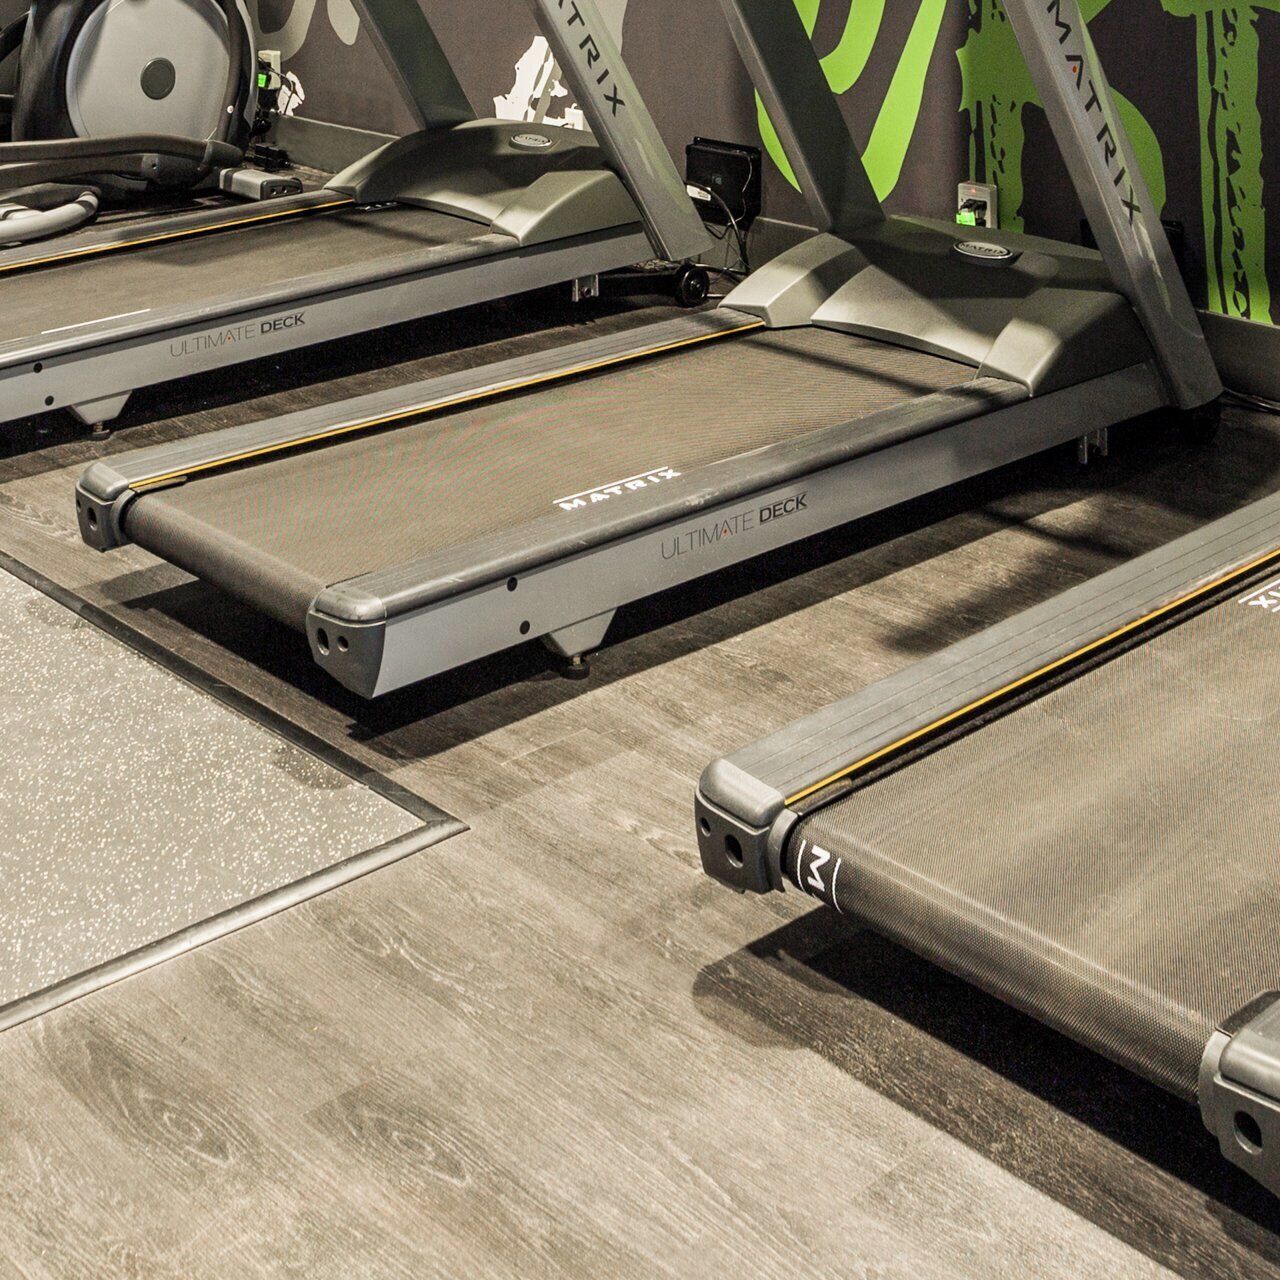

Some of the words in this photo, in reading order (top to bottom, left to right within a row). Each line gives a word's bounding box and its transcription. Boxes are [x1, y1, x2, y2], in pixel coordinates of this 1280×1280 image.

[959, 242, 1007, 255] MATRIX
[169, 323, 257, 358] ULTIMATE
[260, 311, 306, 335] DECK
[558, 468, 682, 512] MATRIX
[660, 509, 756, 560] ULTIMATE
[758, 492, 808, 525] DECK
